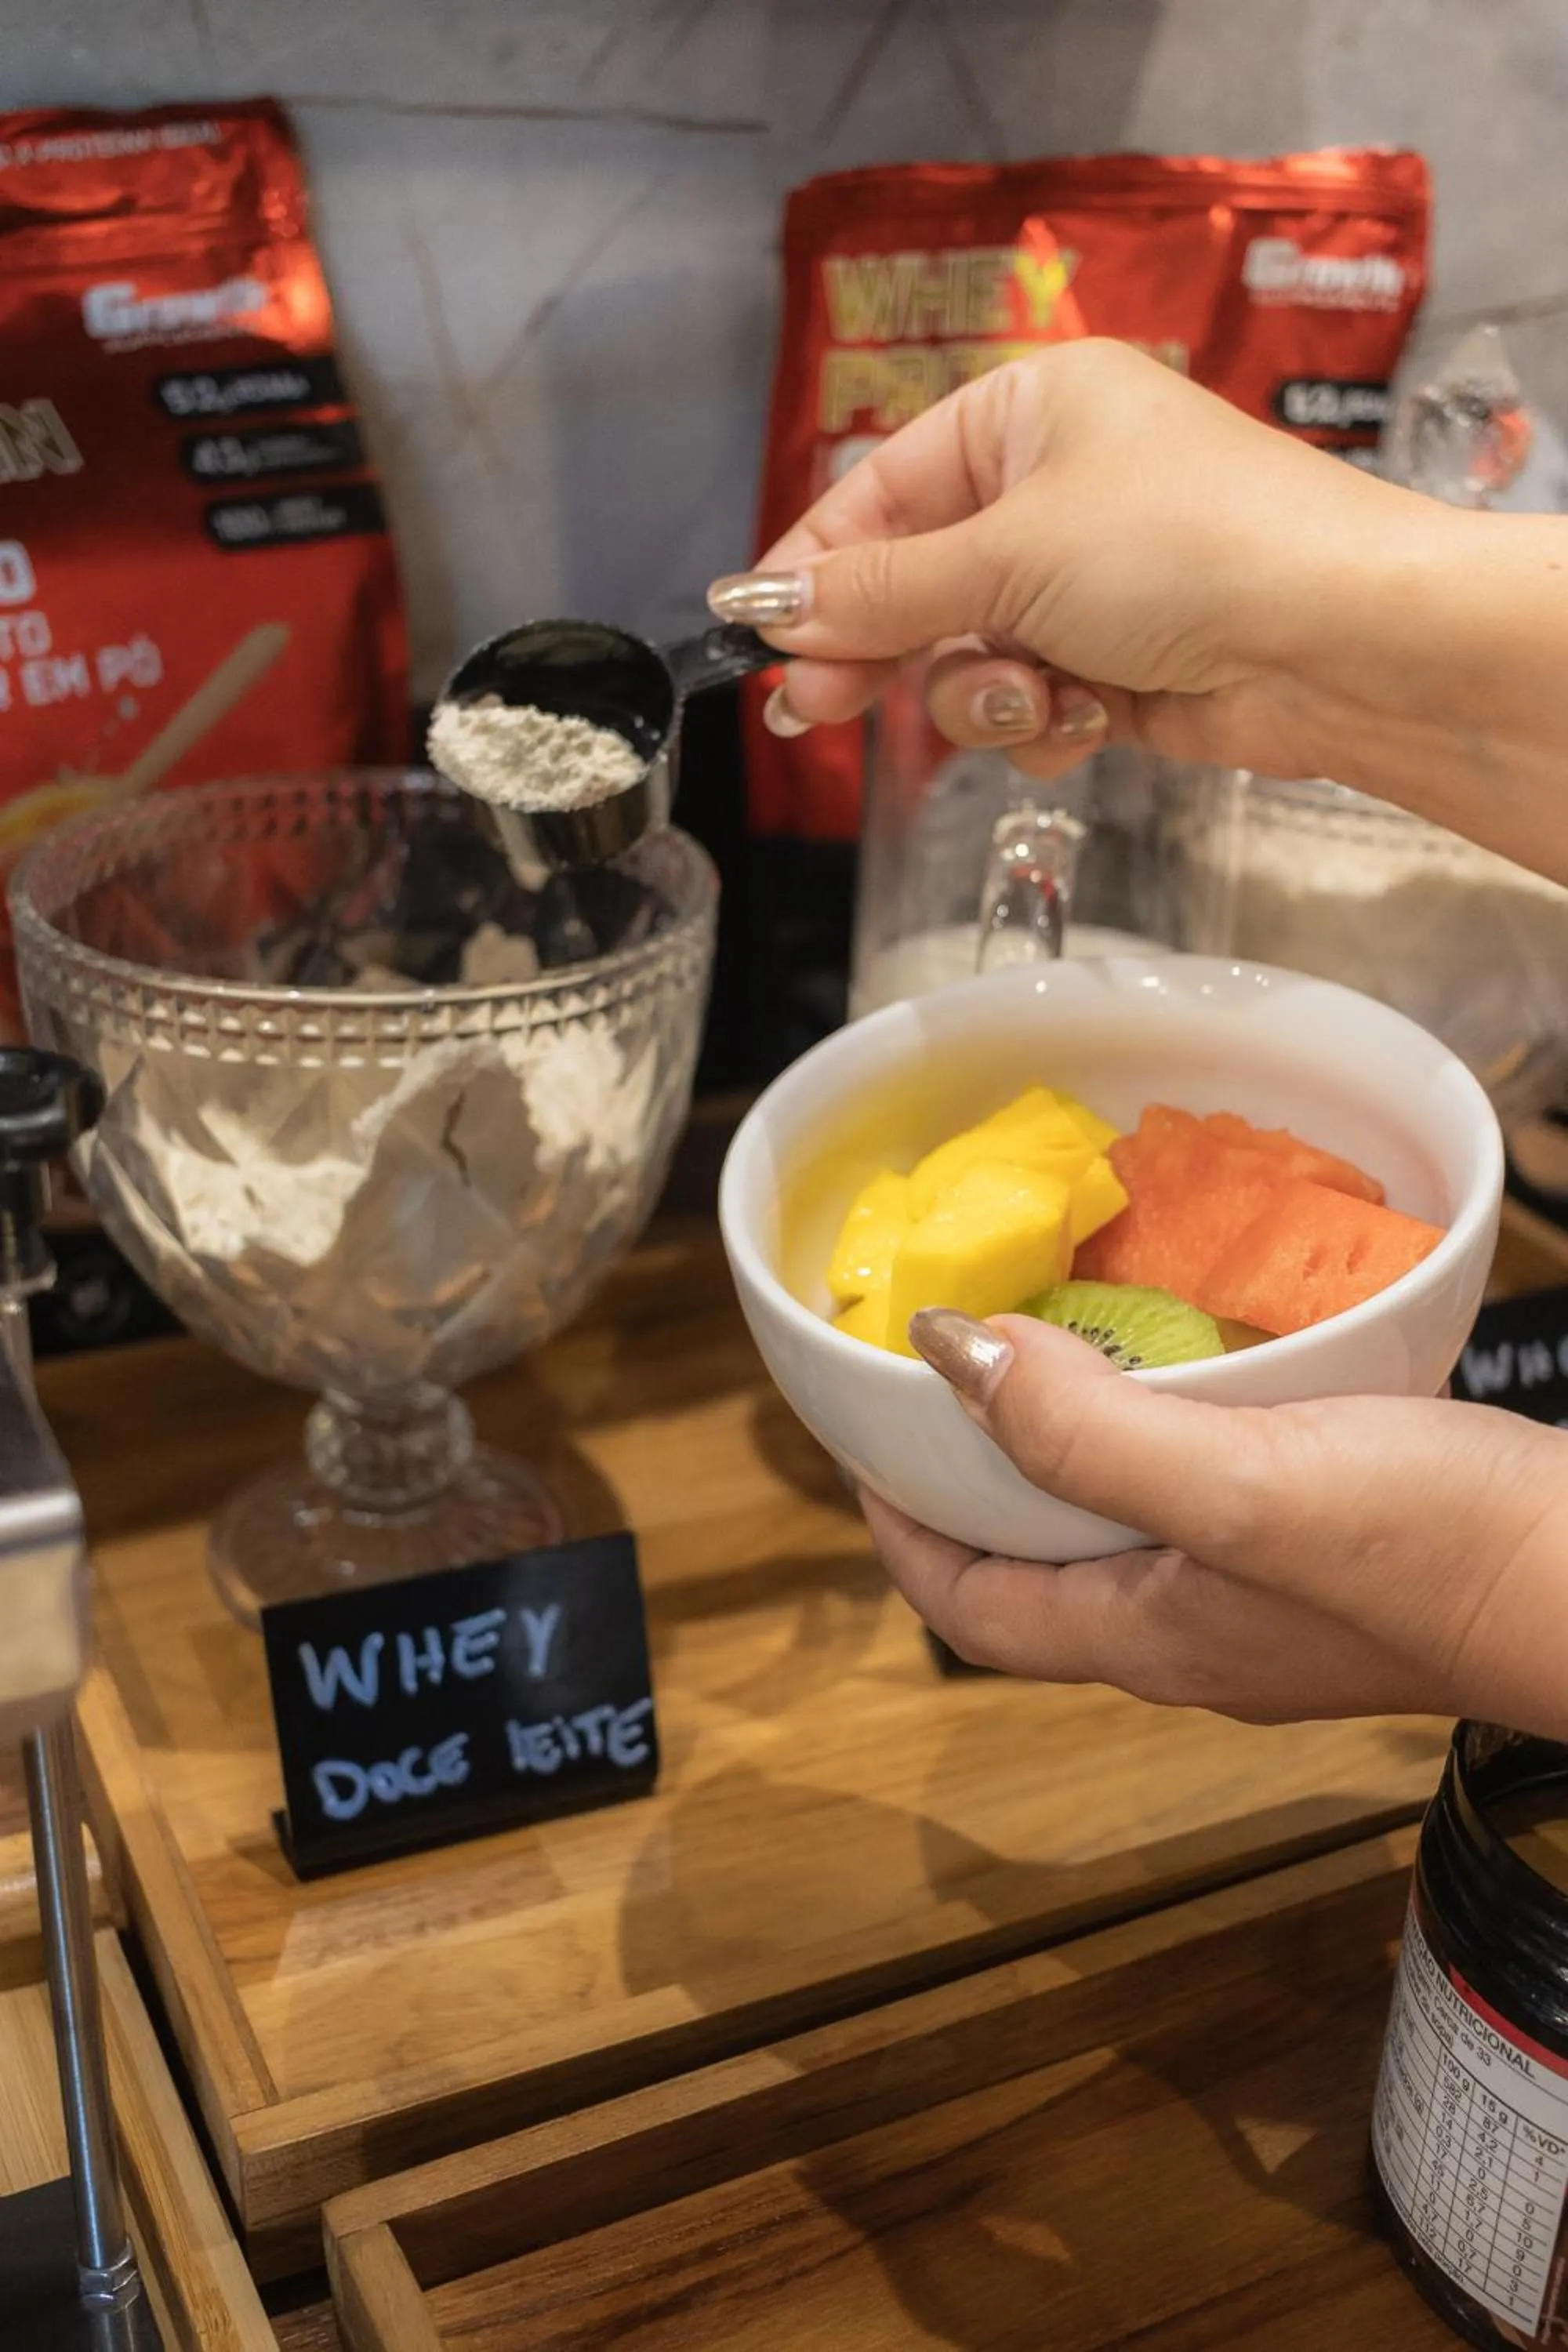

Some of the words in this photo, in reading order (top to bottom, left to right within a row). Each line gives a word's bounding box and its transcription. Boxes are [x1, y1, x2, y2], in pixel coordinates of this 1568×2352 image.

[821, 247, 1081, 341] WHEY
[299, 1602, 561, 1711] WHEY
[312, 1731, 470, 1821] DOCE
[1436, 1972, 1535, 2080] NUTRICIONAL
[1461, 2032, 1474, 2051] de
[1476, 2046, 1491, 2067] 33
[1443, 2053, 1461, 2078] 100
[1462, 2078, 1470, 2092] g
[1482, 2094, 1496, 2113] 15
[1498, 2111, 1508, 2125] g
[1442, 2112, 1453, 2130] 14
[1483, 2116, 1499, 2133] 87
[1534, 2156, 1544, 2166] 4
[1436, 2143, 1447, 2159] 17
[1478, 2167, 1486, 2180] 0
[1525, 2201, 1534, 2215] 0
[1534, 2170, 1540, 2182] 1
[1429, 2191, 1436, 2204] 0
[1466, 2229, 1475, 2242] 0
[1512, 2263, 1522, 2277] 0
[1516, 2232, 1533, 2249] 10
[1516, 2249, 1525, 2262] 9
[1458, 2258, 1472, 2273] 17
[1508, 2295, 1514, 2307] 1
